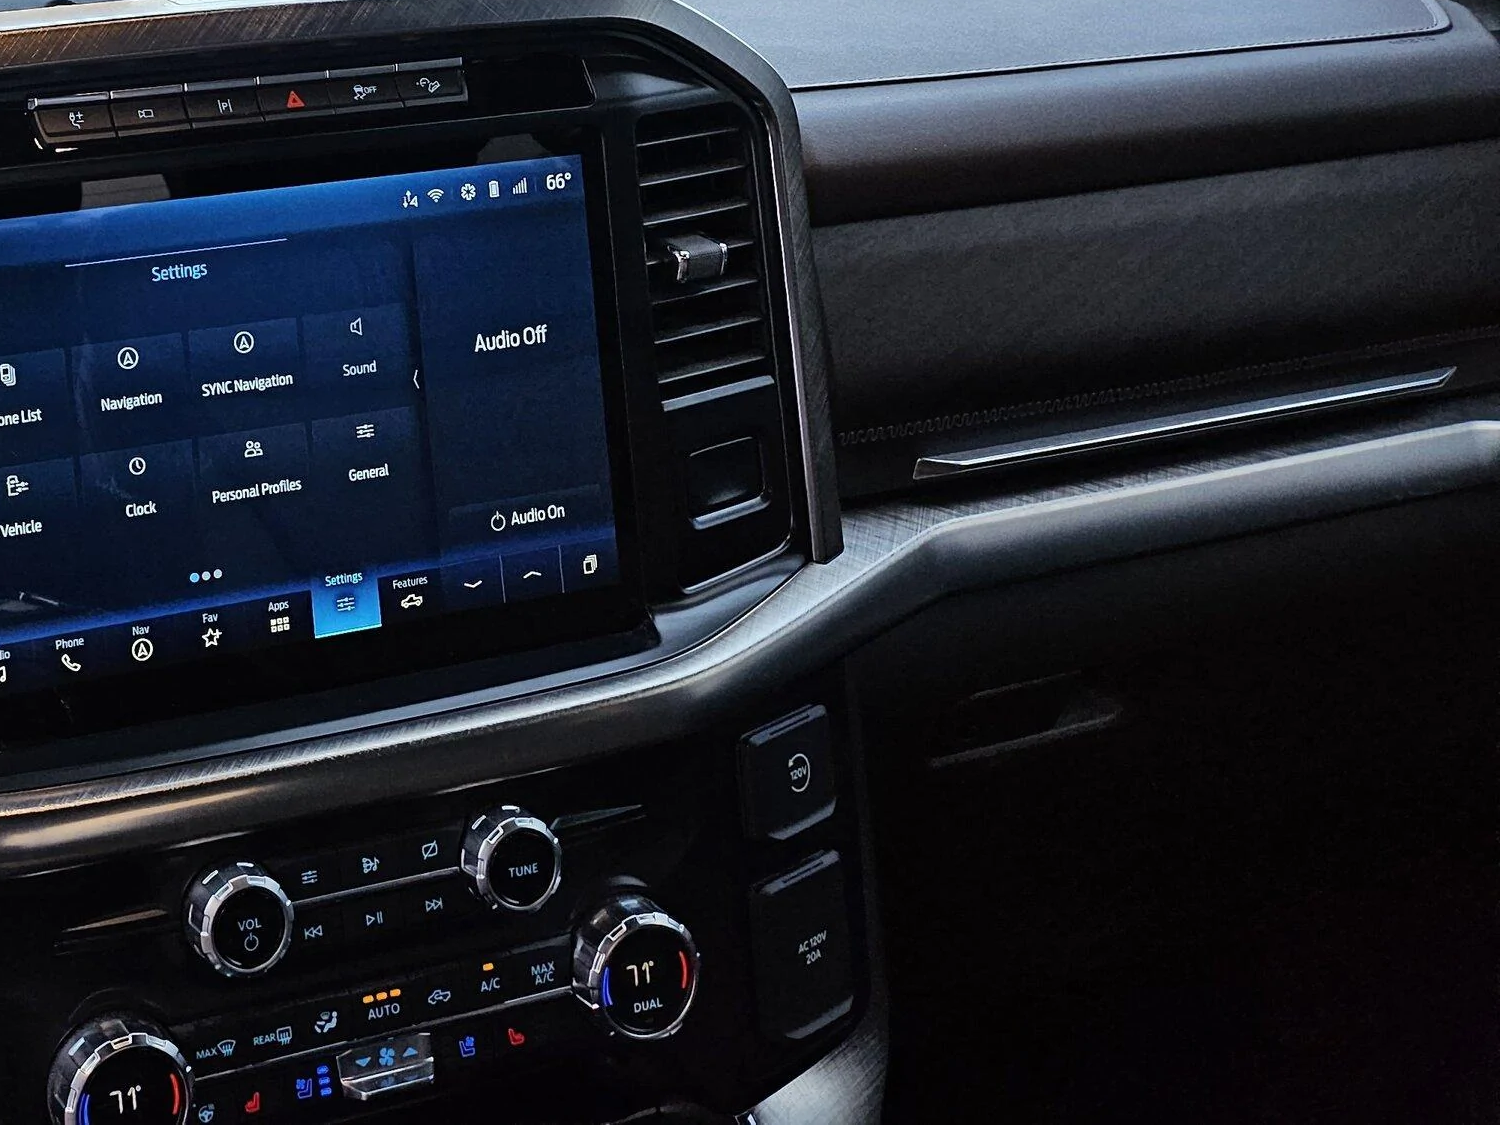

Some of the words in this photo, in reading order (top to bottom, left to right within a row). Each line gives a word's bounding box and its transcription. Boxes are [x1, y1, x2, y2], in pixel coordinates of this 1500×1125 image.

[364, 85, 377, 94] OFF
[151, 261, 208, 282] Settings
[474, 330, 521, 353] Audio
[523, 323, 549, 346] Off
[342, 360, 377, 377] Sound
[201, 380, 233, 397] SYNC
[234, 374, 294, 393] Navigation
[100, 391, 163, 411] Navigation
[21, 408, 43, 424] List
[348, 463, 390, 482] General
[212, 483, 260, 503] Personal
[261, 478, 302, 495] Profiles
[125, 500, 157, 518] Clock
[510, 508, 546, 526] Audio
[547, 503, 566, 519] On
[0, 519, 43, 538] Vehicle
[324, 571, 363, 588] Settings
[392, 575, 428, 590] Features
[268, 599, 289, 613] Apps
[202, 612, 218, 624] Fav
[132, 625, 150, 637] Nav
[55, 636, 85, 650] Phone
[789, 764, 807, 781] 120V
[508, 862, 539, 878] TUNE
[237, 917, 262, 932] VOL
[798, 939, 809, 955] AC
[809, 929, 827, 948] 120V
[805, 948, 822, 966] 20A
[531, 960, 555, 976] MAX
[480, 977, 500, 993] A/C
[534, 971, 554, 986] A/C
[367, 1002, 401, 1020] AUTO
[633, 999, 663, 1014] DUAL
[253, 1032, 277, 1046] REAR
[196, 1046, 218, 1059] MAX
